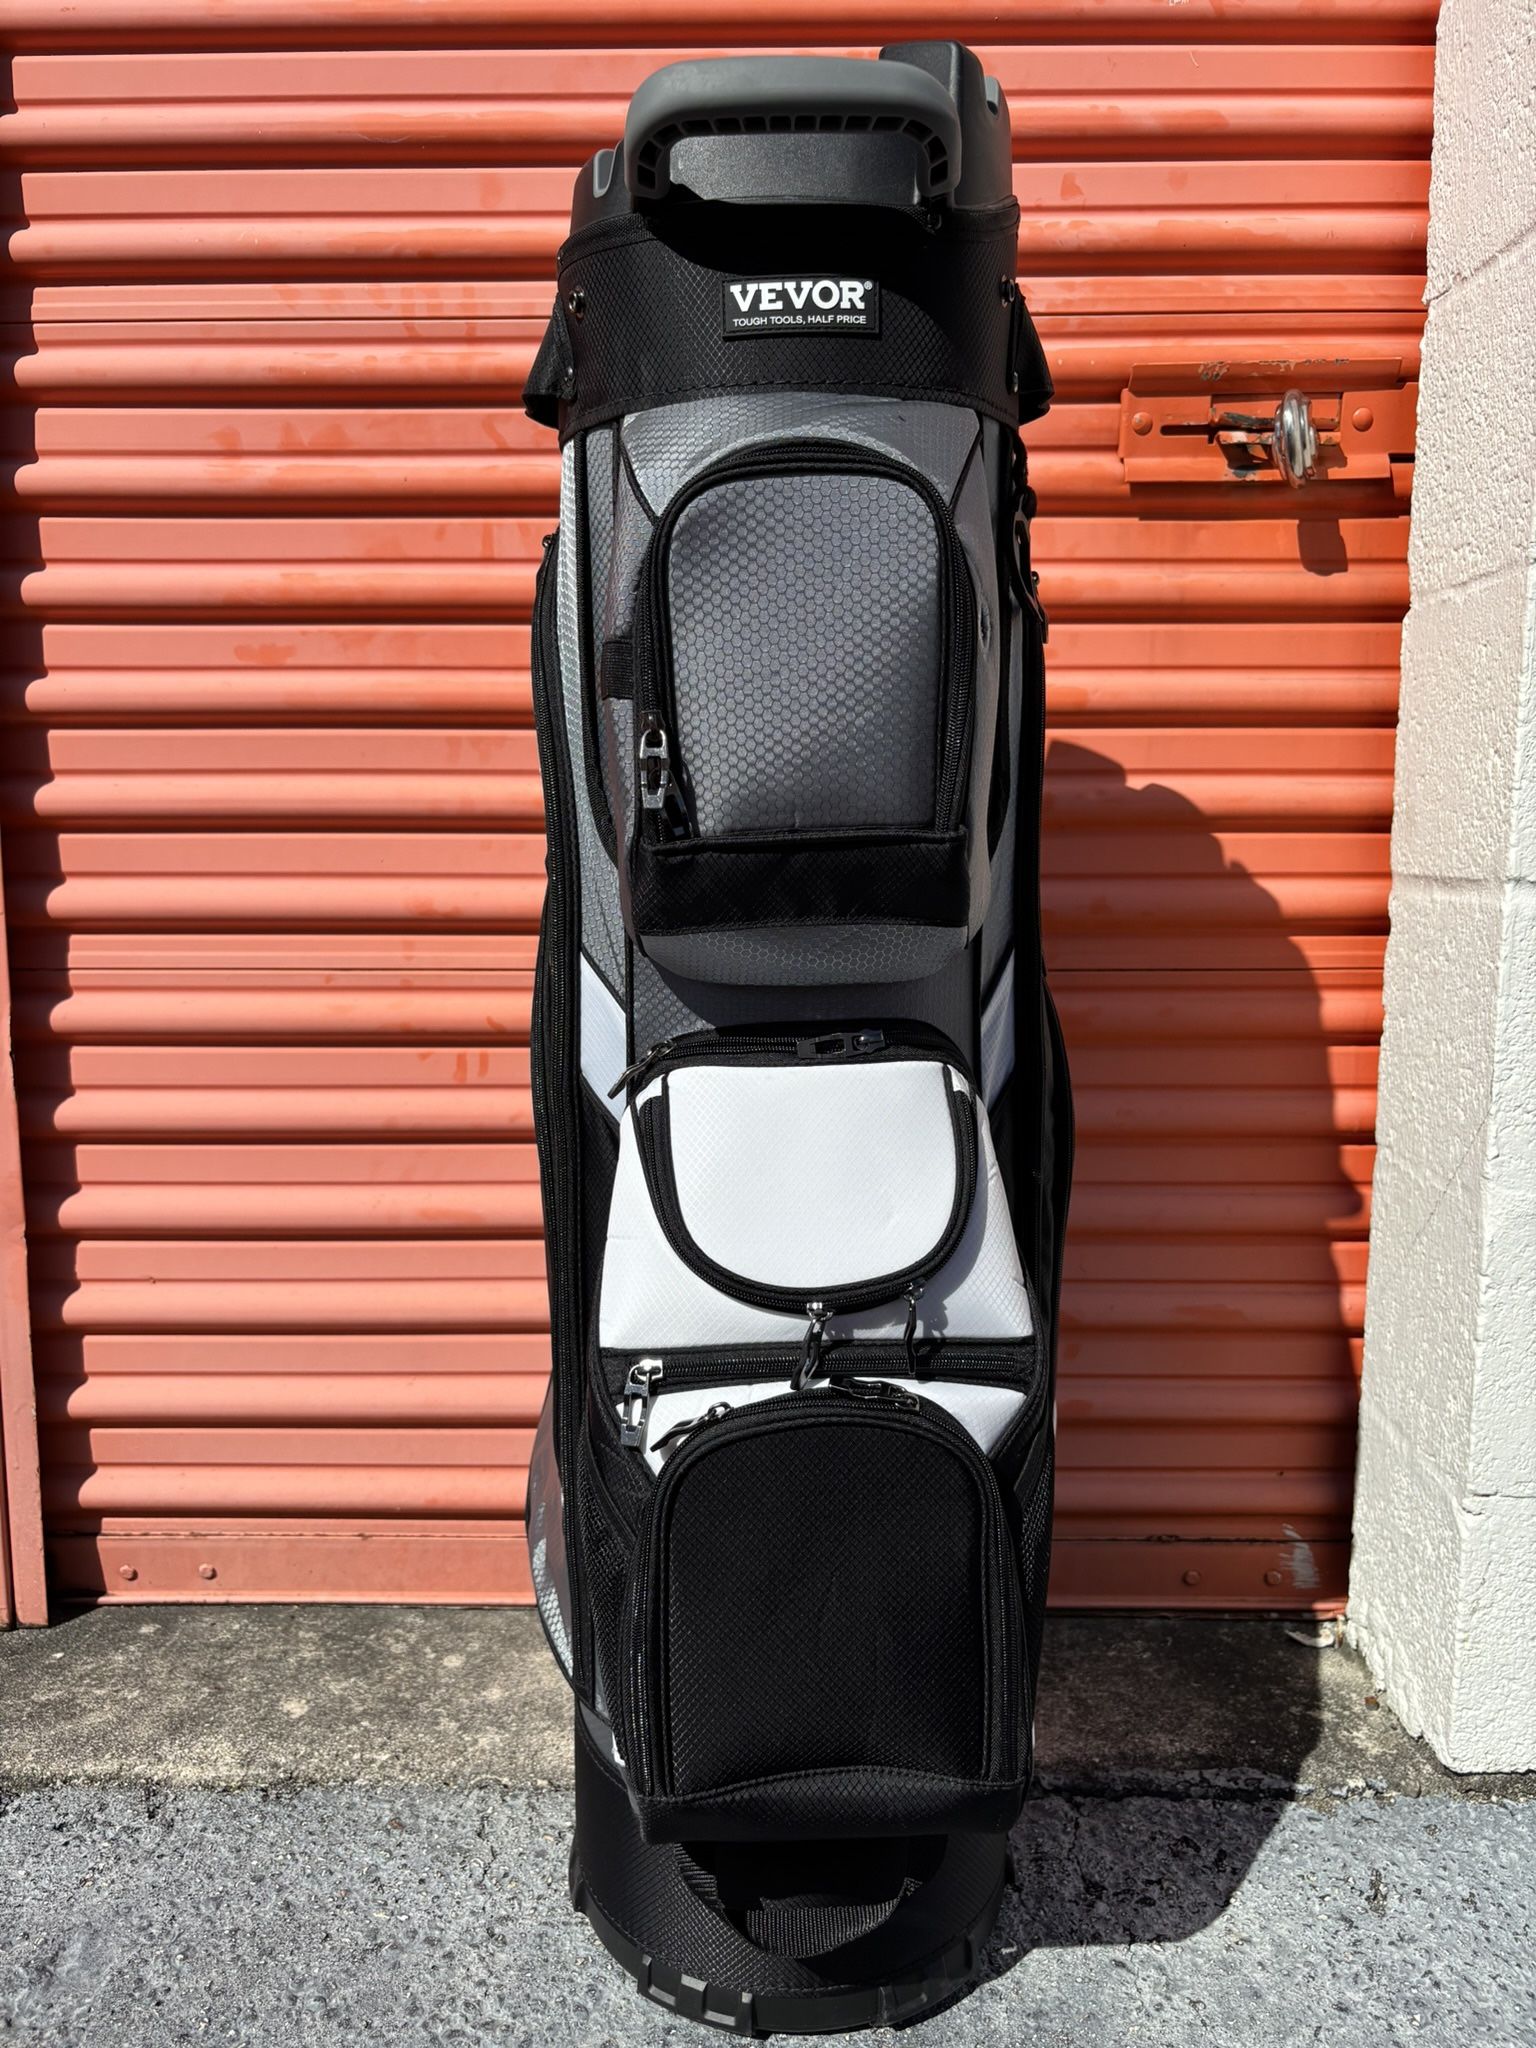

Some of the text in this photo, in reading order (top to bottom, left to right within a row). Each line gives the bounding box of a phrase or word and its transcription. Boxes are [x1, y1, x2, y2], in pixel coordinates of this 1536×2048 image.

[733, 314, 866, 326] TOUGH TOOLS, HALF PRICE
